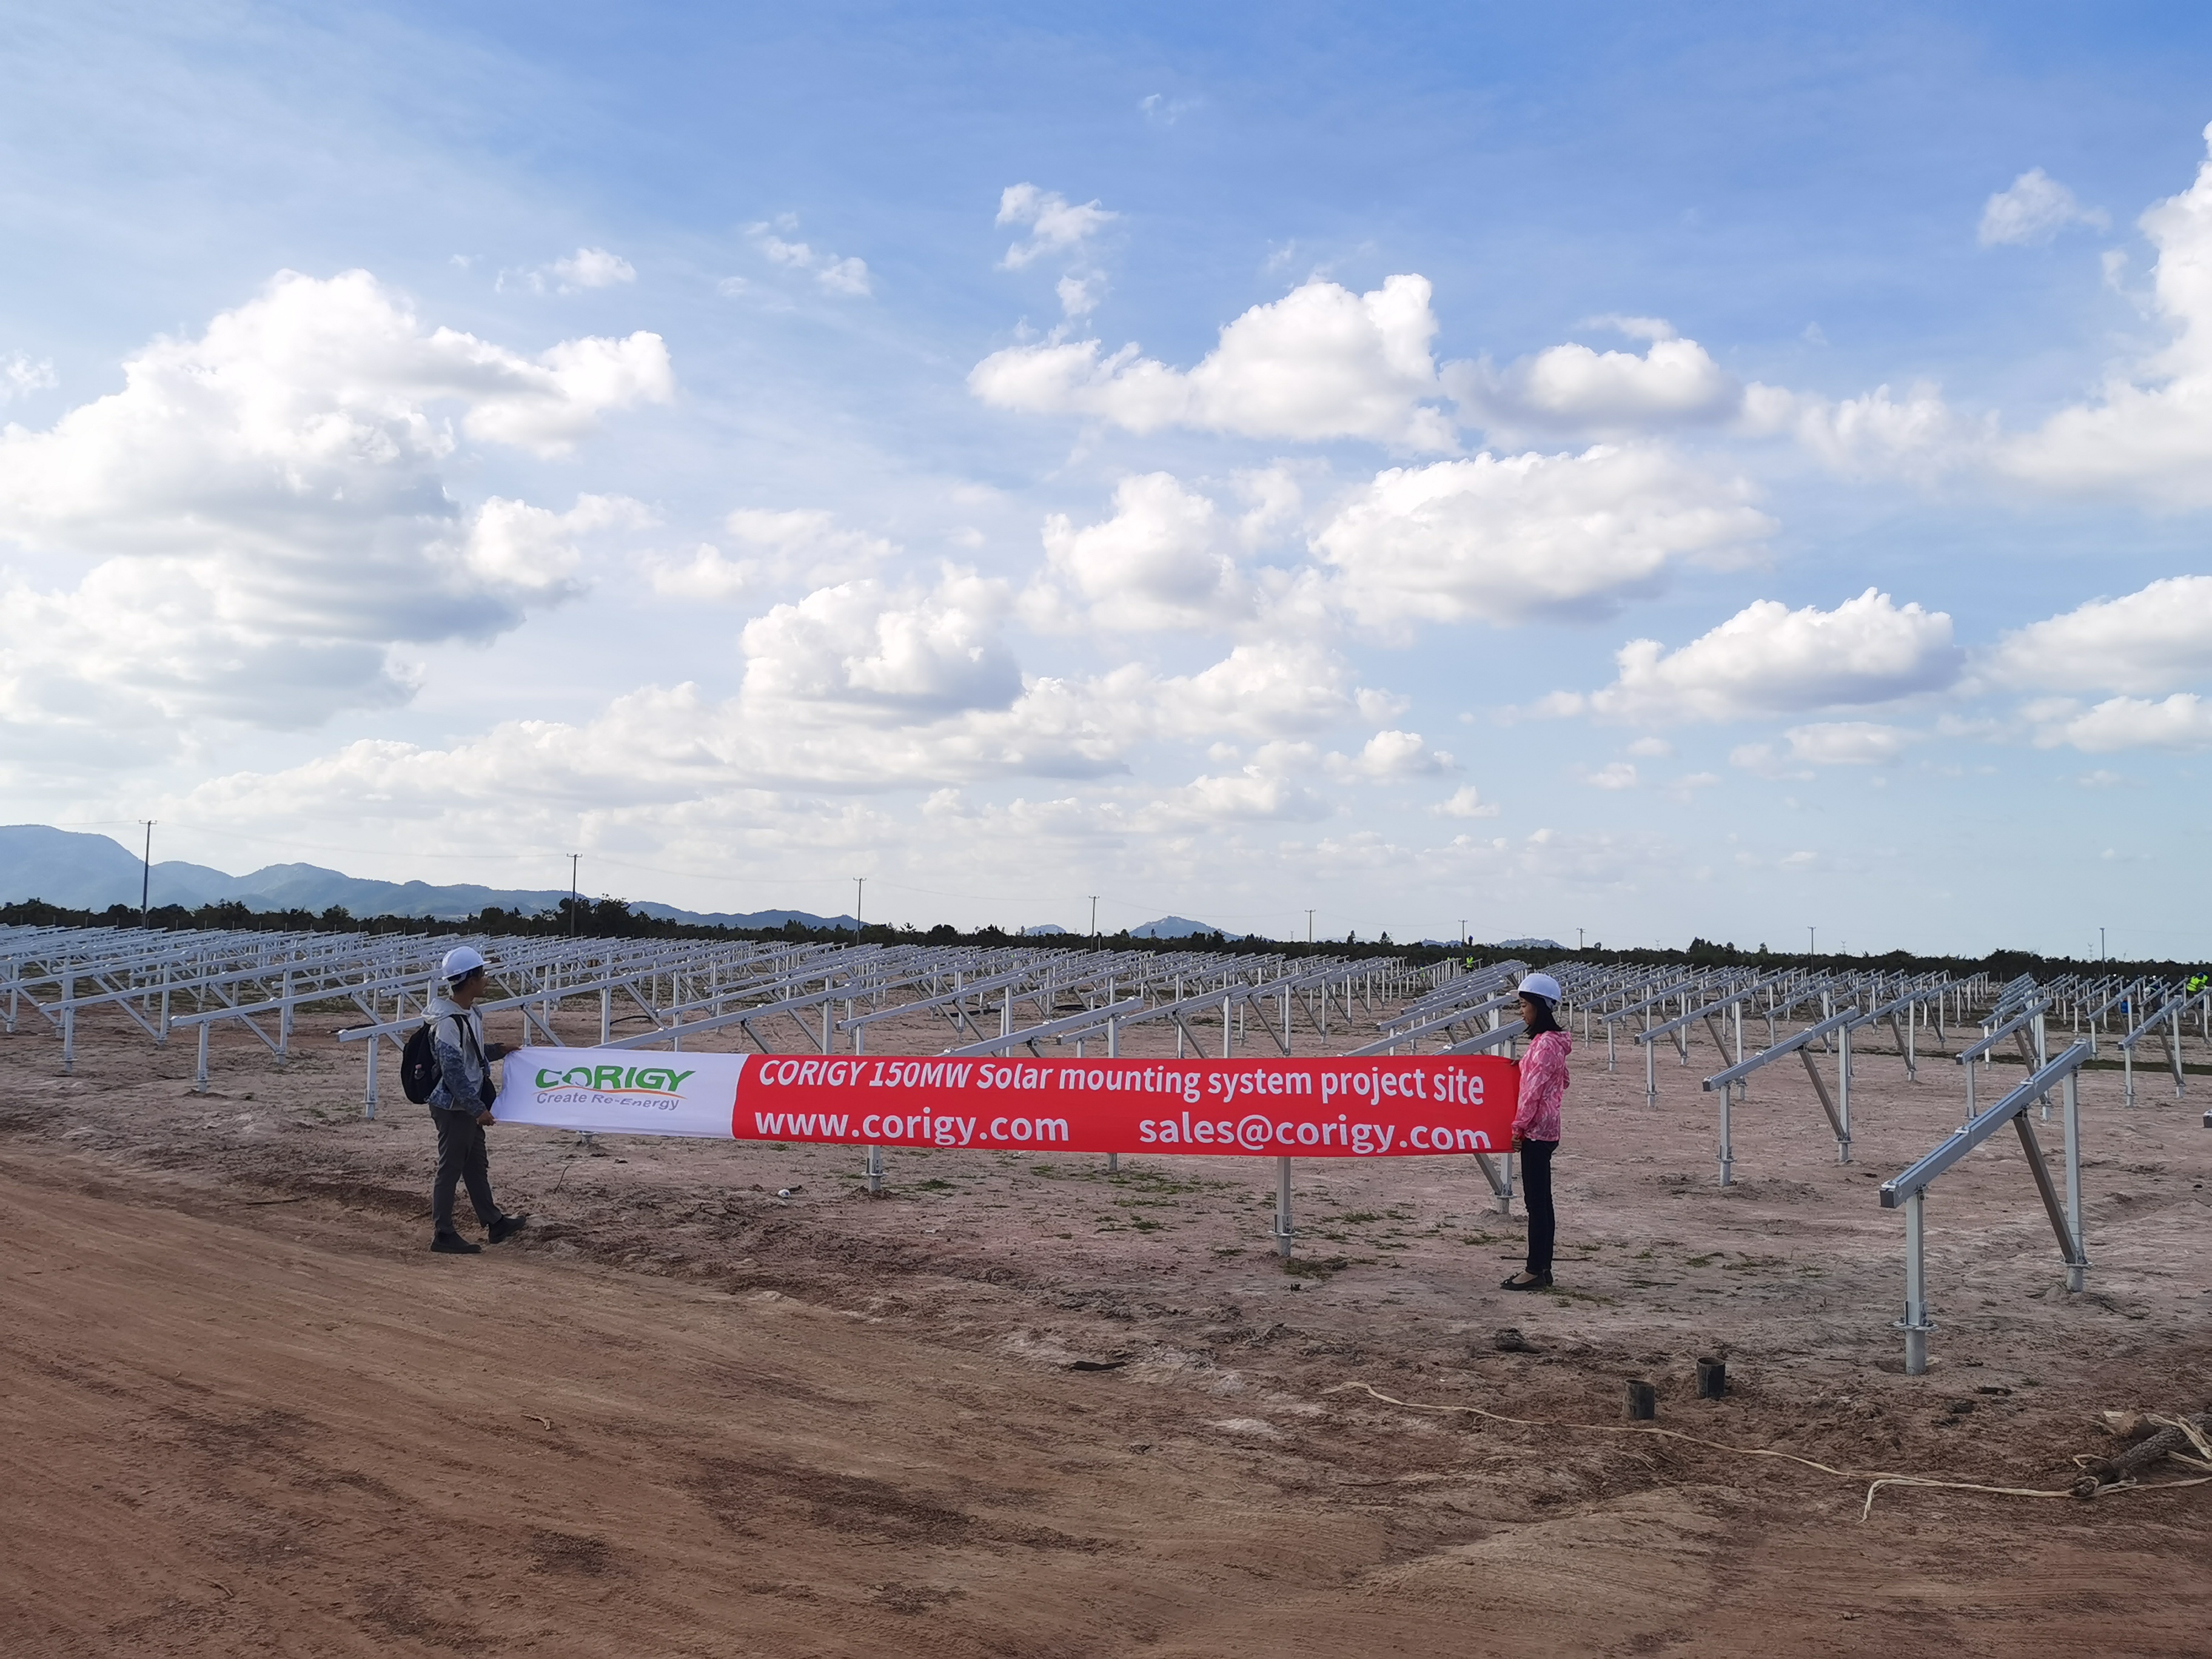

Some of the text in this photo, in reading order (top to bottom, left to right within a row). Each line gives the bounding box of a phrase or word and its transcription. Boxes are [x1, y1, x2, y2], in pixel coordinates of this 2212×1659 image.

[535, 1065, 695, 1092] CORIGY
[759, 1059, 1484, 1105] CORIGY 150MW Solar mounting system project site
[536, 1092, 679, 1110] Create Re-Energy
[754, 1107, 1069, 1146] www.corigy.com
[1139, 1111, 1491, 1155] sales@corigy.com
